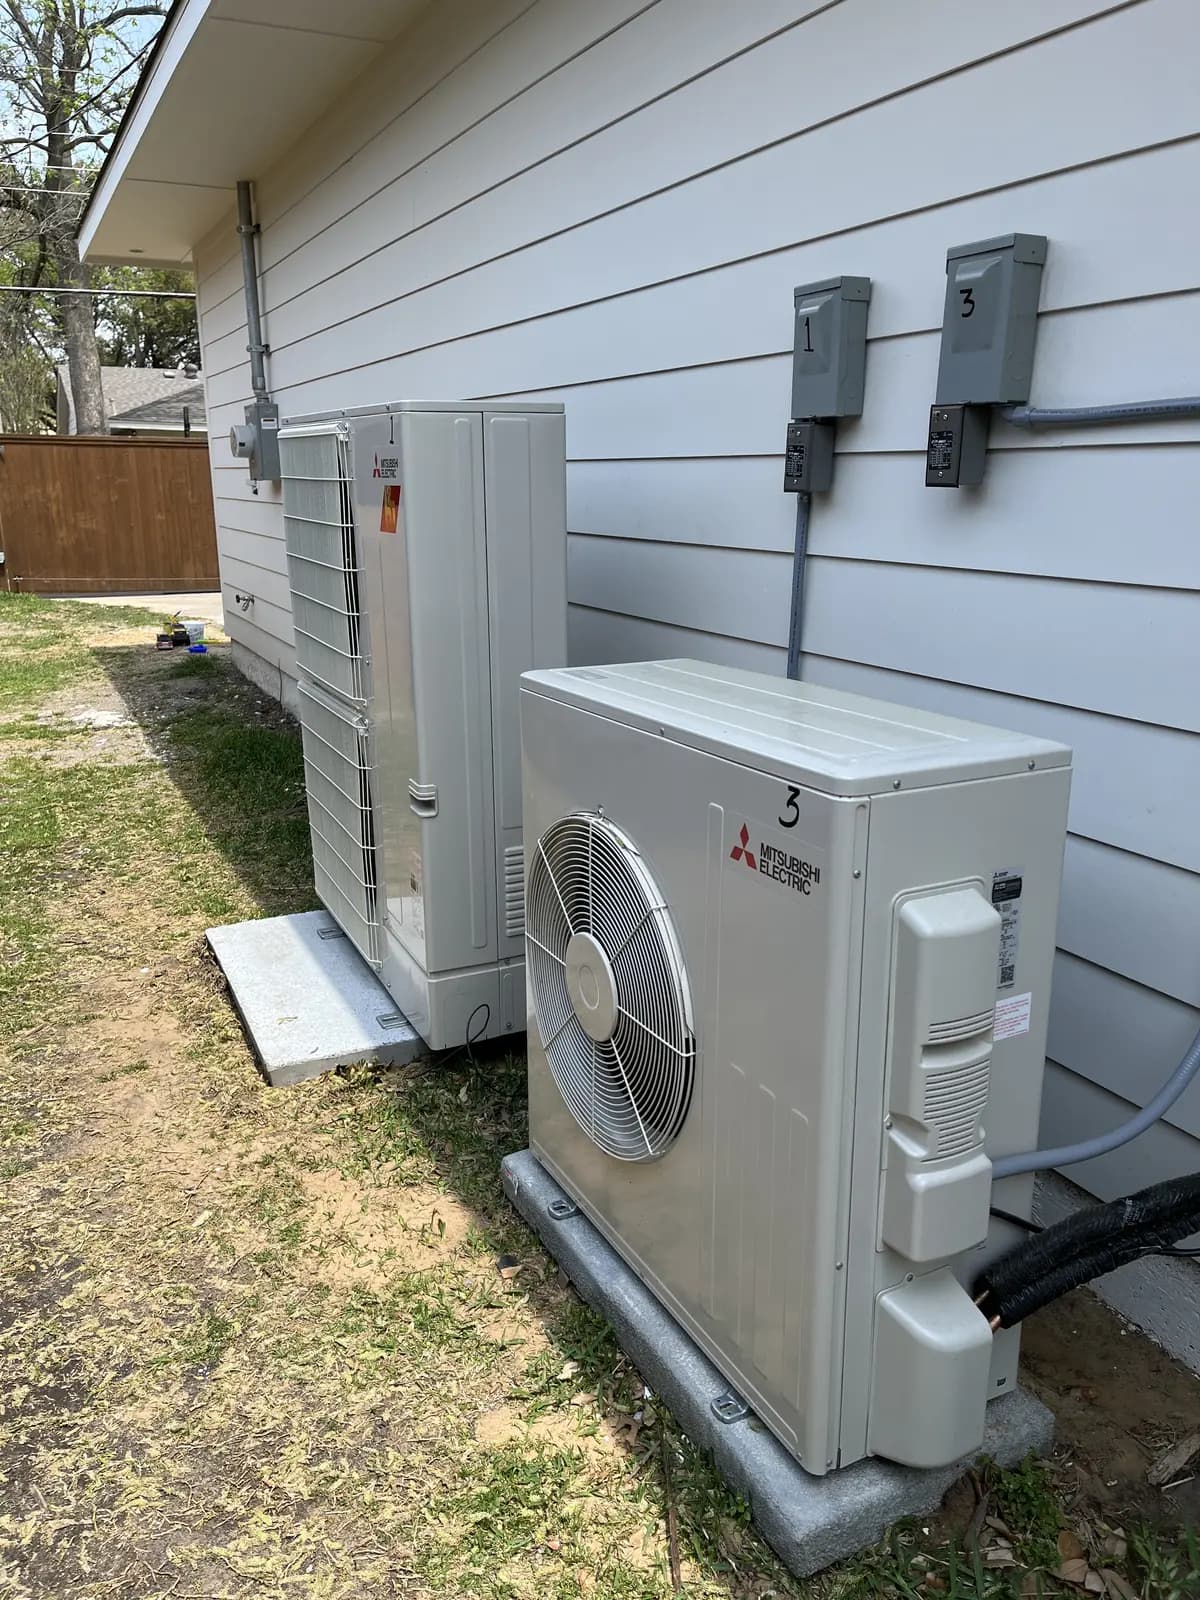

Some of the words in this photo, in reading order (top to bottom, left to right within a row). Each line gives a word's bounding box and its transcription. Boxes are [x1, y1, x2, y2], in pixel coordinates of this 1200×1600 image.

[960, 288, 975, 318] 3
[803, 316, 814, 352] 1
[778, 785, 801, 828] 3
[759, 858, 811, 895] ELECTRIC
[760, 842, 820, 884] MITSUBISHI
